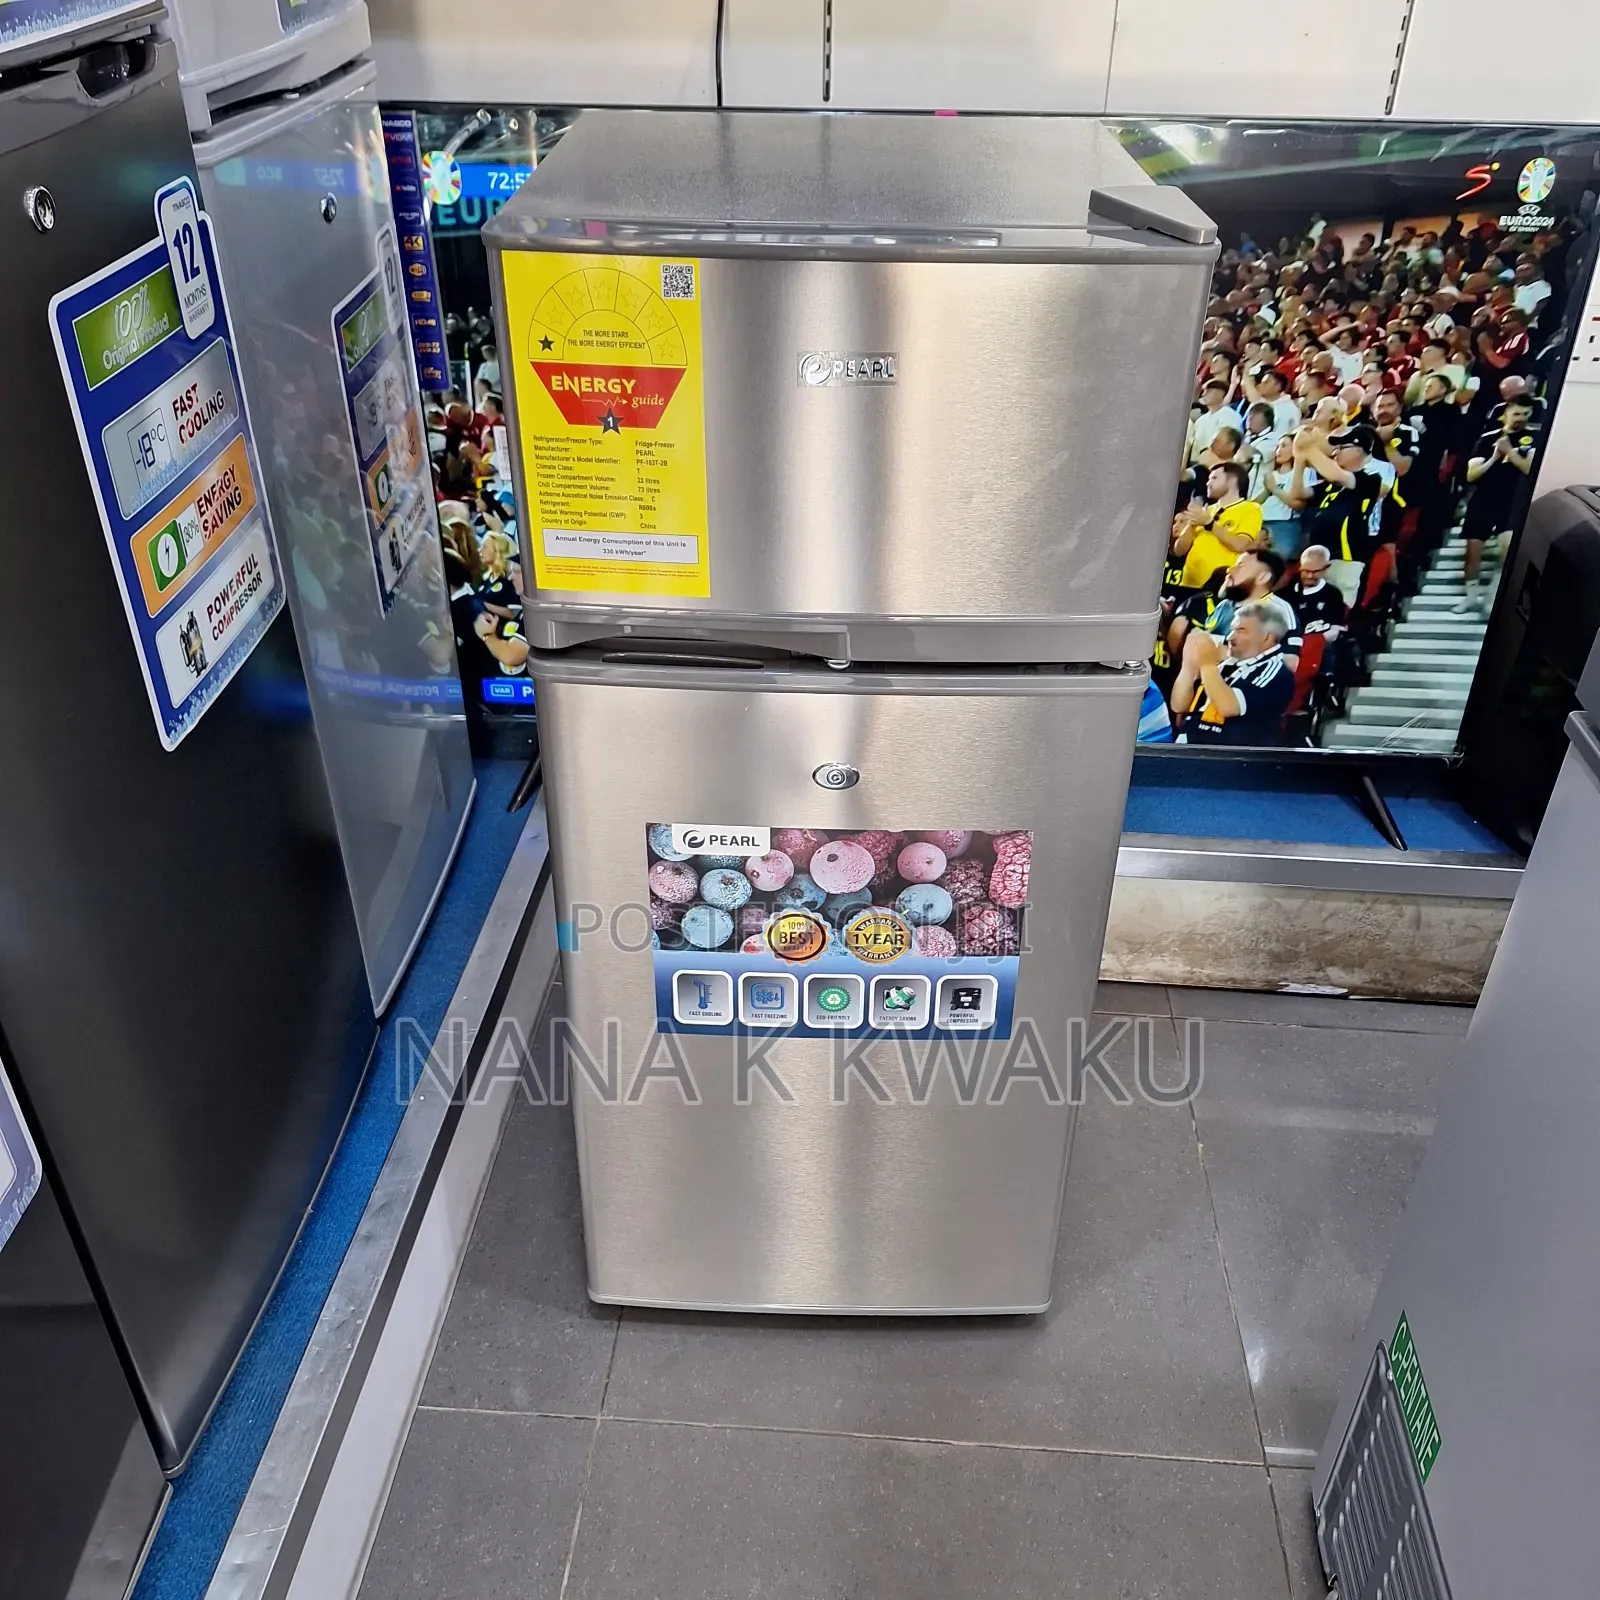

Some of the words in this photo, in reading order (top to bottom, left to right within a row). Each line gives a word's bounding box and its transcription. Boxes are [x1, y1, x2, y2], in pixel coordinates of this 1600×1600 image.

[487, 171, 531, 190] 72:5
[173, 222, 201, 284] 12
[184, 284, 207, 309] MONTHS
[188, 303, 210, 324] WARRANTY
[103, 331, 140, 370] Original
[139, 312, 170, 346] Product
[594, 330, 610, 338] MORE
[612, 331, 629, 339] STARS
[567, 339, 579, 347] THE
[596, 341, 618, 349] ENERGY
[832, 358, 895, 378] PEARL
[551, 371, 637, 398] ENERGY
[172, 382, 199, 421] FAST
[631, 393, 665, 408] guide
[179, 389, 225, 444] COOLING
[607, 416, 614, 428] 1
[533, 435, 588, 444] Refrigerator/Freezer
[589, 438, 604, 446] Type:
[635, 440, 675, 448] Fridge-Freezer
[534, 444, 572, 452] Manufacturer:
[535, 454, 575, 462] Manufacturer's
[557, 473, 593, 481] Compartment
[196, 463, 237, 519] ENERGY
[551, 482, 587, 490] Compartment
[540, 499, 571, 507] Refrigerant:
[202, 486, 242, 541] SAVING
[559, 509, 582, 518] Warming
[541, 517, 562, 525] Country
[570, 518, 587, 526] Origin
[579, 536, 600, 544] Energy
[602, 537, 644, 546] Consumption
[206, 553, 259, 623] POWERFUL
[212, 571, 263, 641] COMPRESSOR
[709, 834, 761, 847] PEARL
[857, 917, 901, 932] WARRANTY
[779, 931, 816, 945] BEST
[858, 945, 899, 960] WARRANTY
